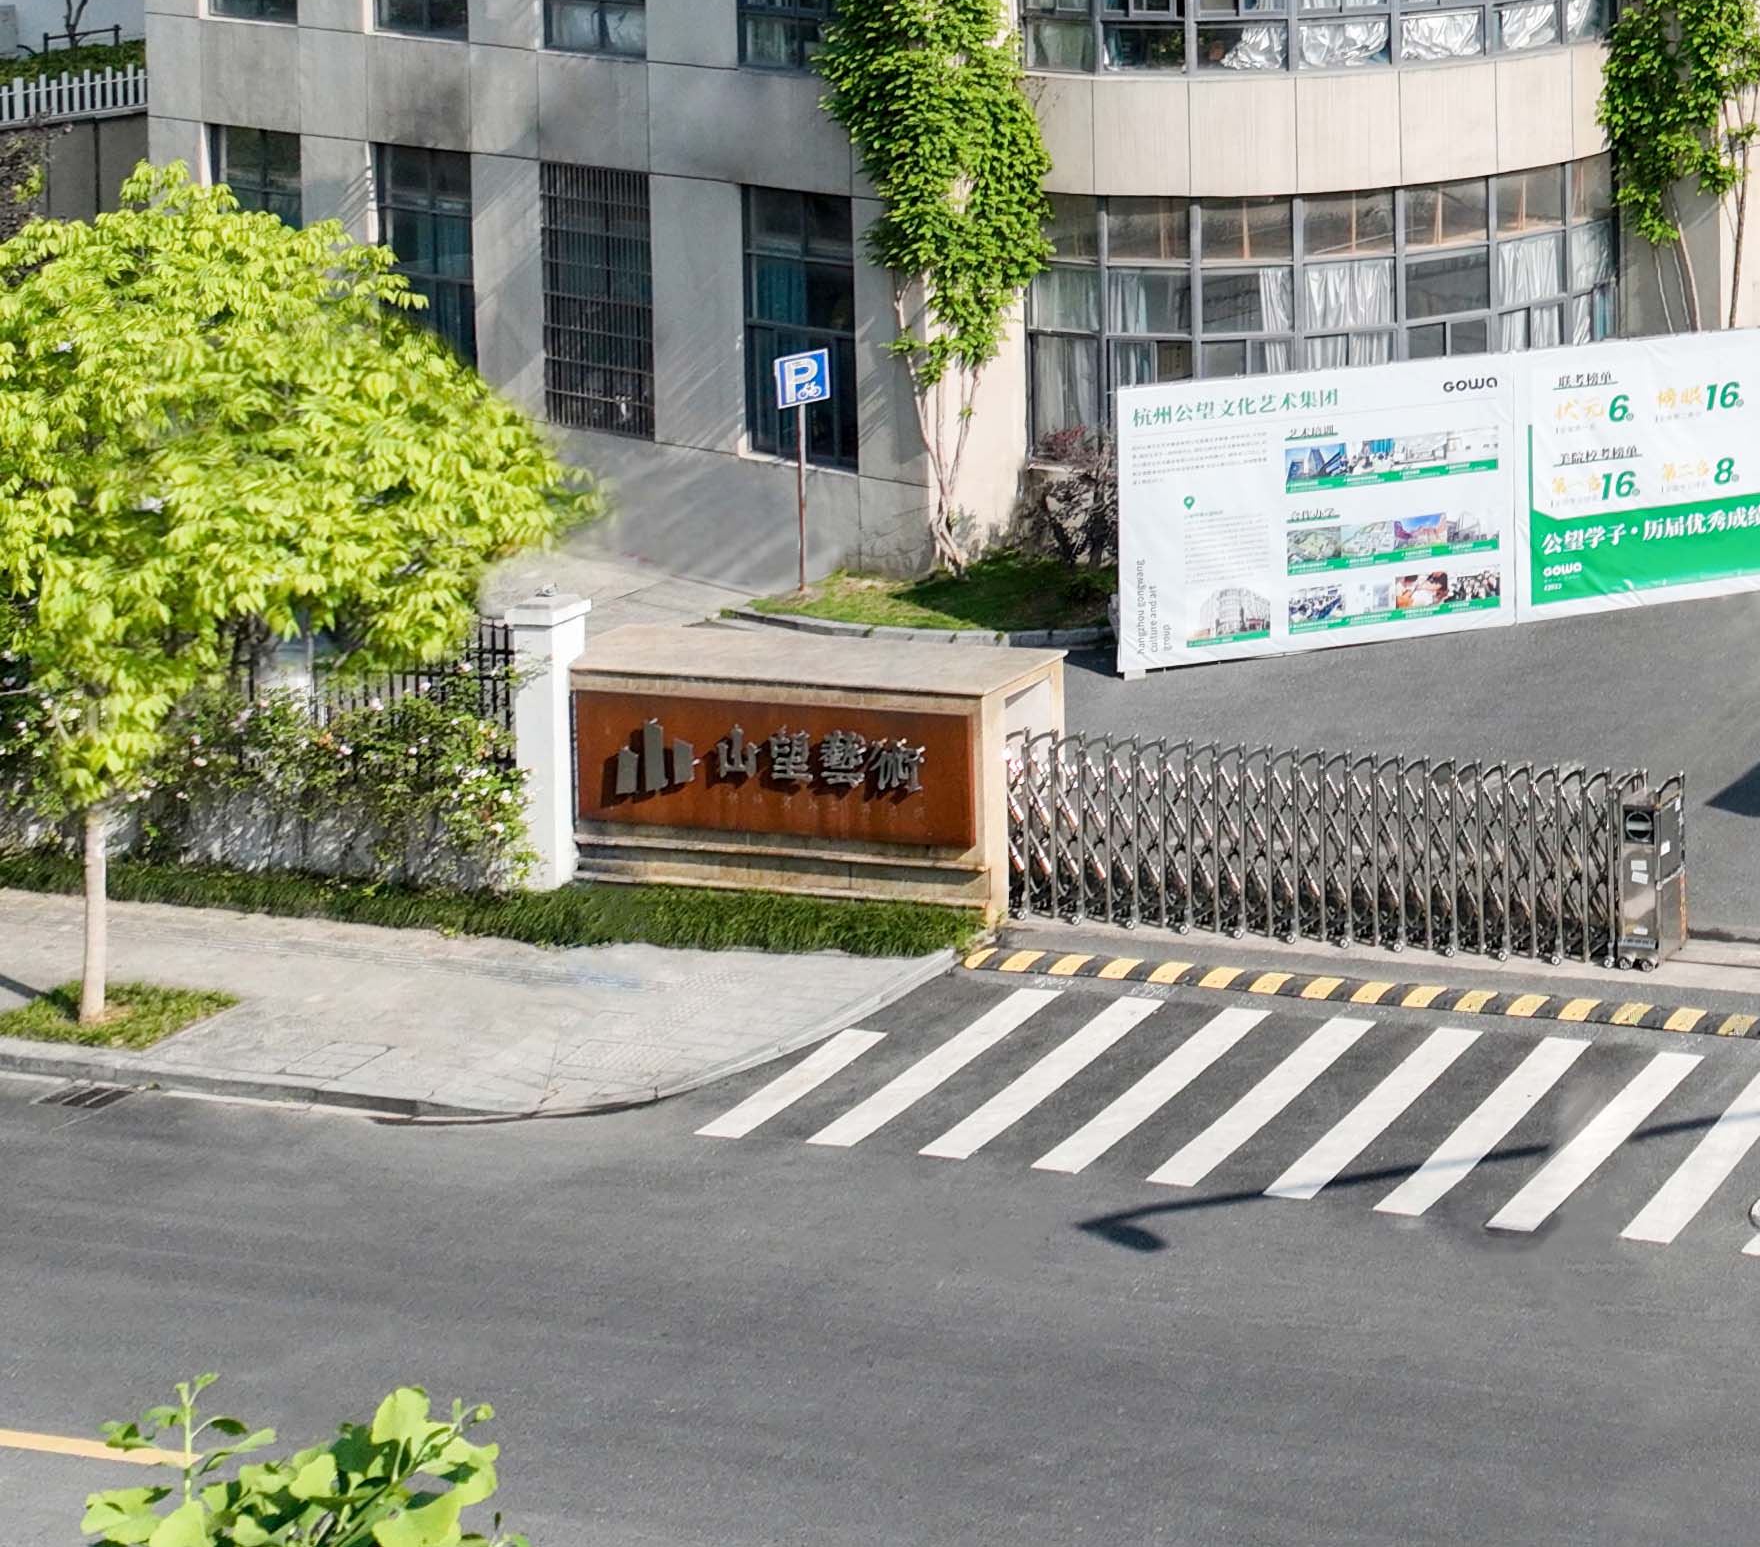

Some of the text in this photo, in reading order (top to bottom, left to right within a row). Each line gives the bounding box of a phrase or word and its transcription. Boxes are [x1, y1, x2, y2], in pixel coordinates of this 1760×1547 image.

[785, 358, 818, 404] P
[1706, 382, 1740, 411] 16
[1133, 388, 1339, 428] 杭州公望文化艺术集团
[1609, 394, 1630, 422] 6
[1601, 470, 1637, 501] 16
[1713, 457, 1735, 485] 8
[716, 723, 926, 793] 山望藝術
